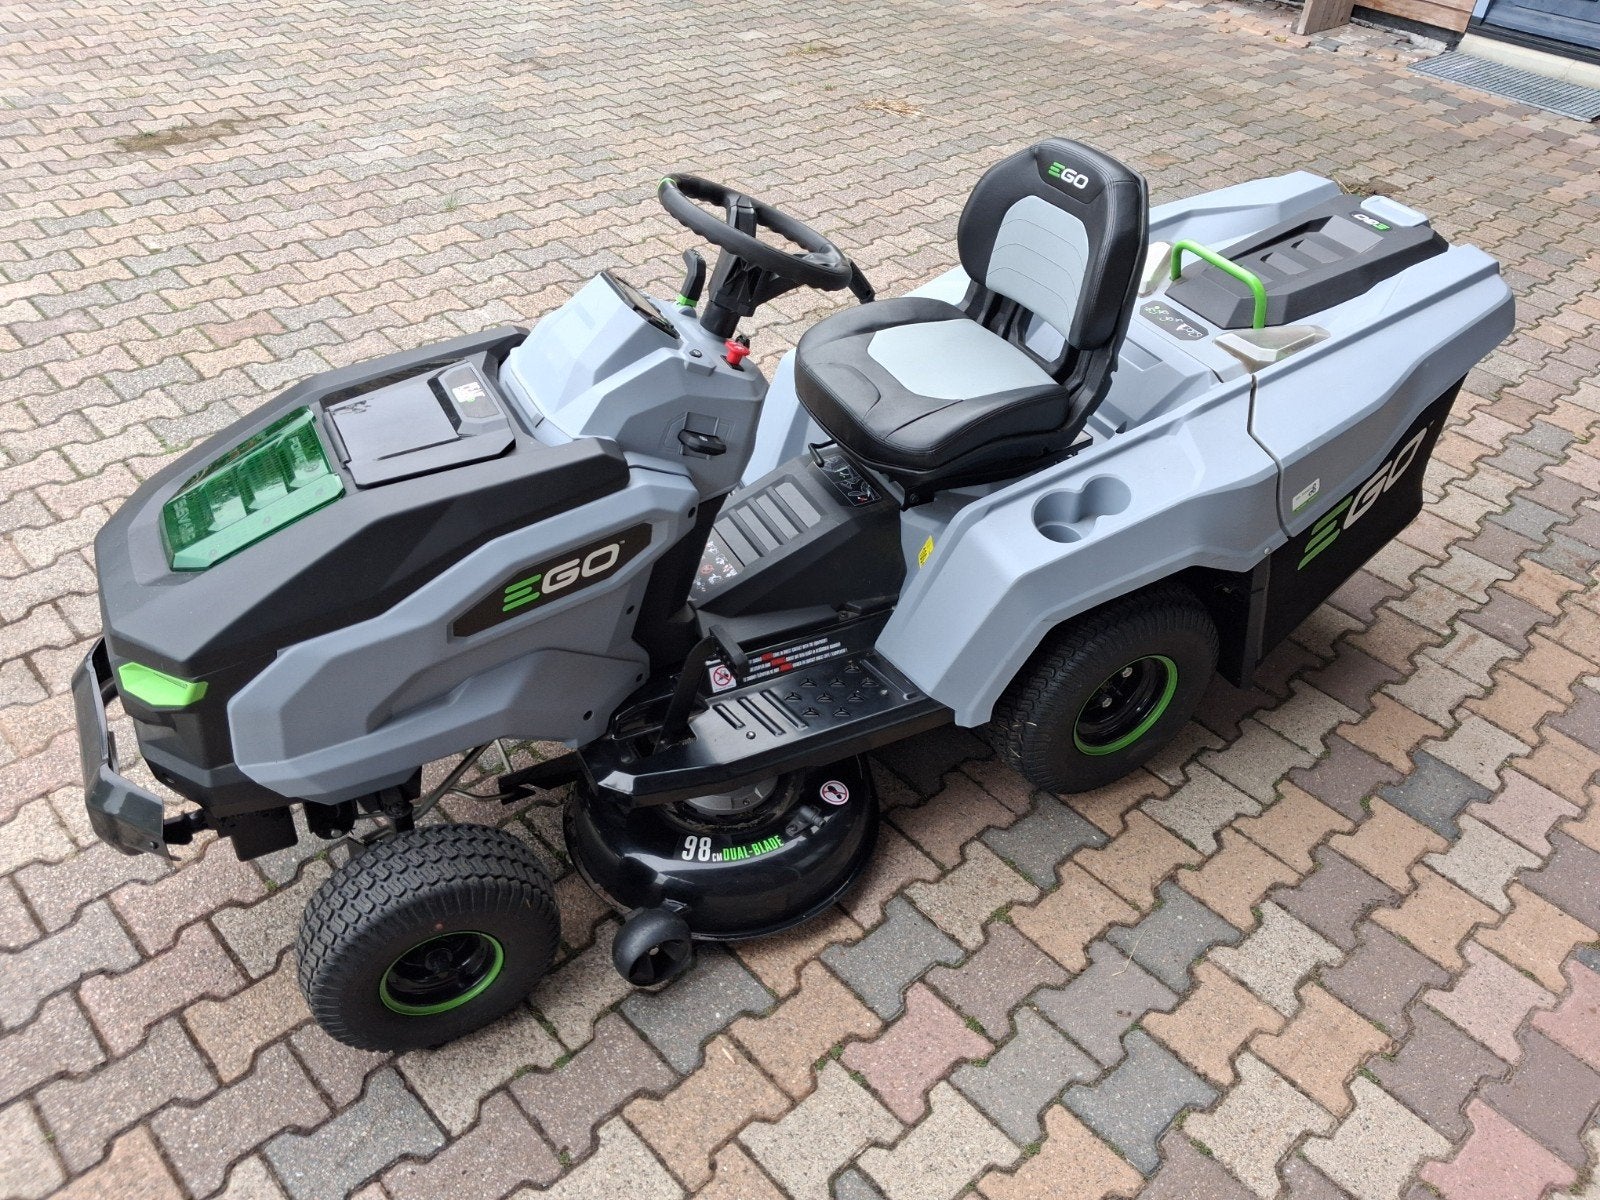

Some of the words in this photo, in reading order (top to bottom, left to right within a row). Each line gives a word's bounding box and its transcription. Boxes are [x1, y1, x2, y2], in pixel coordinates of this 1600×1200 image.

[1048, 161, 1089, 190] EGO
[1297, 426, 1428, 571] EGO
[502, 542, 621, 612] EGO
[681, 835, 712, 862] 98
[722, 834, 785, 862] DUAL-BLADE
